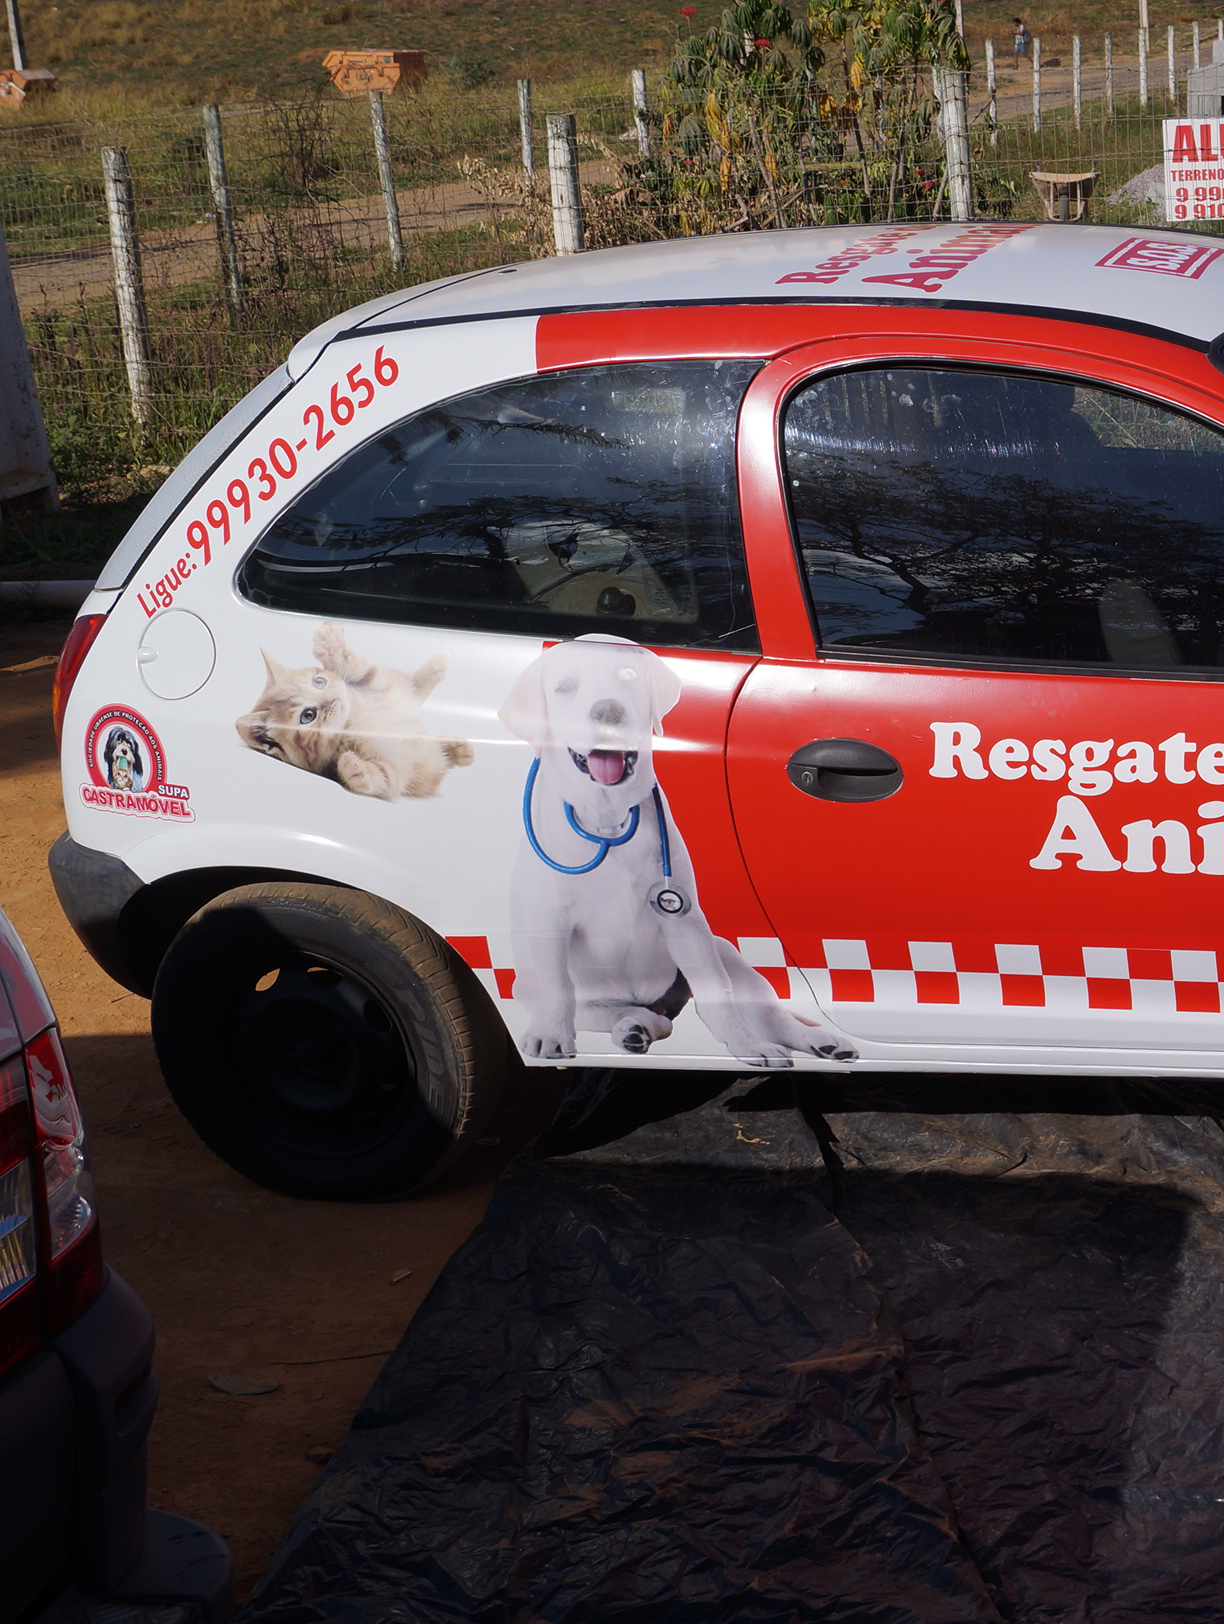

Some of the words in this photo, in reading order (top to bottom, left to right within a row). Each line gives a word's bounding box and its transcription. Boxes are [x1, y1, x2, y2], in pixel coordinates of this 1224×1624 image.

[1171, 168, 1224, 182] TERRENO
[1176, 187, 1189, 203] 9
[1174, 204, 1188, 220] 9
[774, 232, 918, 284] Resgate
[136, 552, 197, 619] Ligue:
[186, 344, 399, 566] 99930-2656
[158, 785, 189, 799] SUPA
